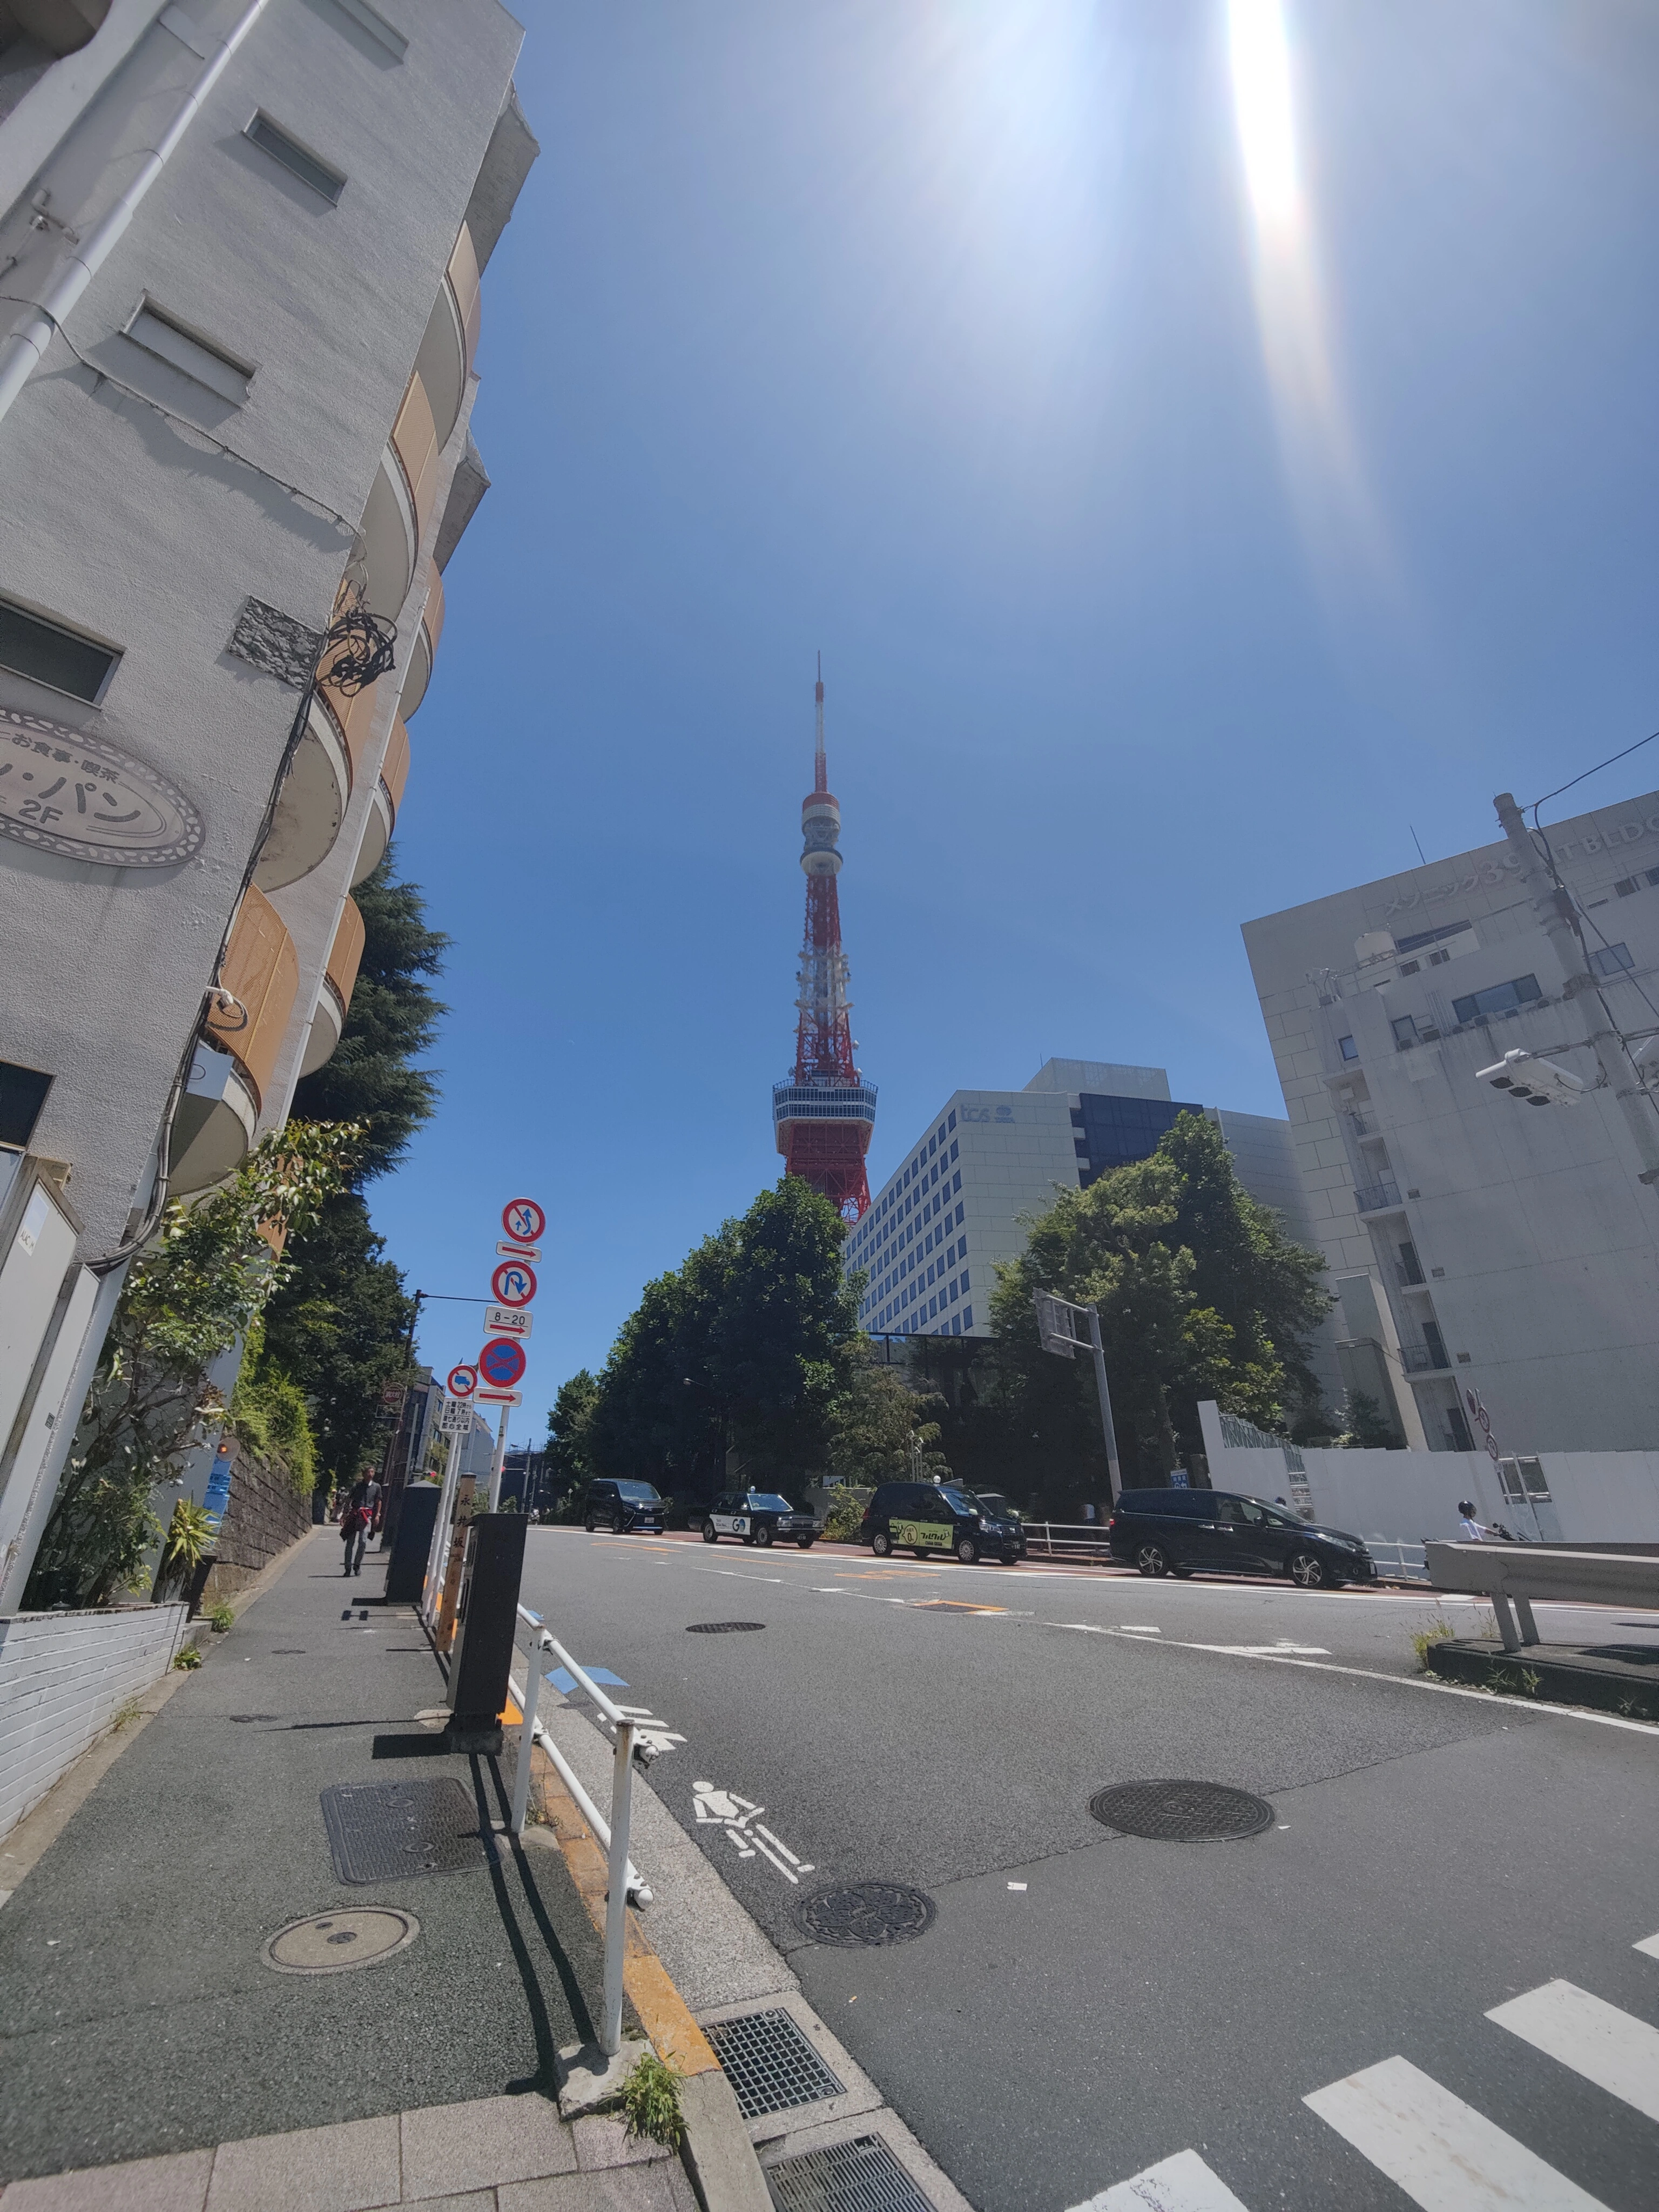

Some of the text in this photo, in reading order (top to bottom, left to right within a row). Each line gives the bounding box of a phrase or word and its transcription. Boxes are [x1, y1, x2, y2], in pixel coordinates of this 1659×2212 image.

[0, 763, 141, 823] ・パン
[18, 799, 64, 824] 2F
[732, 1518, 746, 1533] GO
